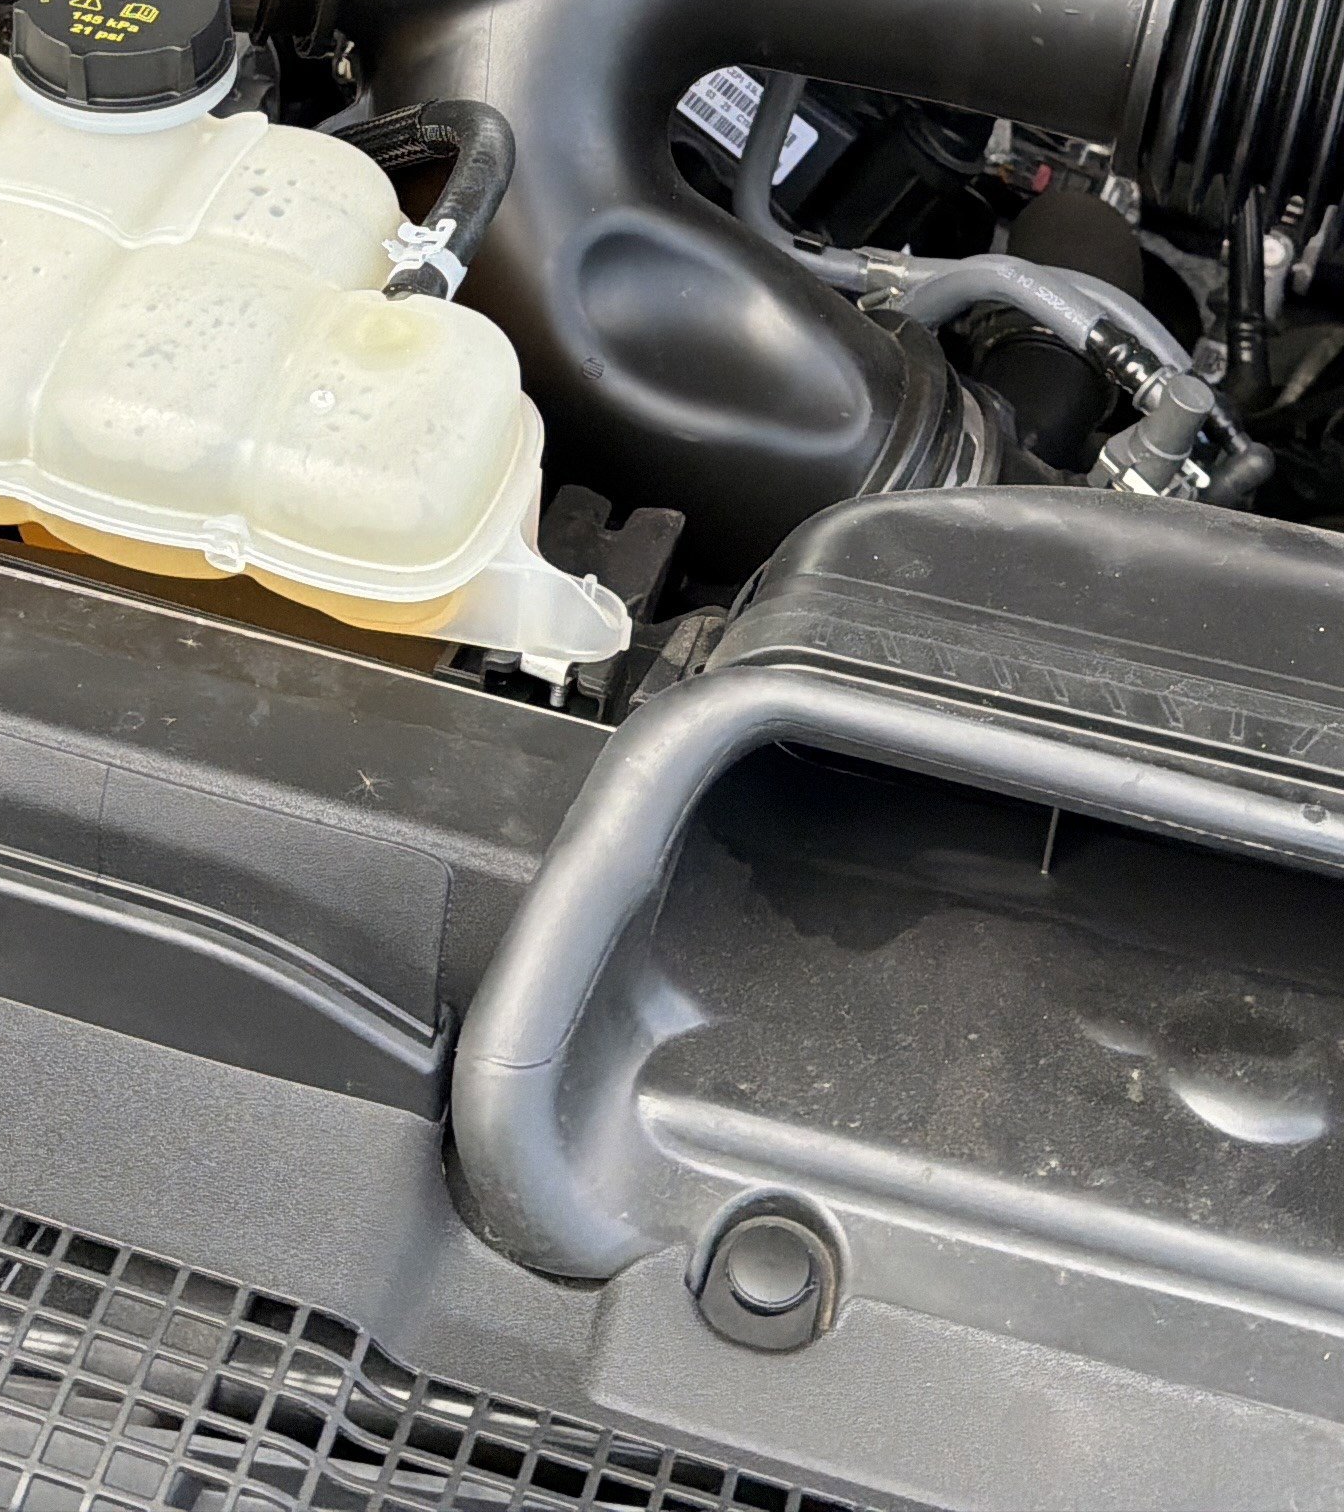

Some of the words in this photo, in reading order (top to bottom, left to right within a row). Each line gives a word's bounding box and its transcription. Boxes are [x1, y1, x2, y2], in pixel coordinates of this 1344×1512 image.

[72, 11, 104, 24] 145
[106, 18, 139, 33] kPa
[69, 23, 93, 35] 21
[94, 31, 125, 42] psi
